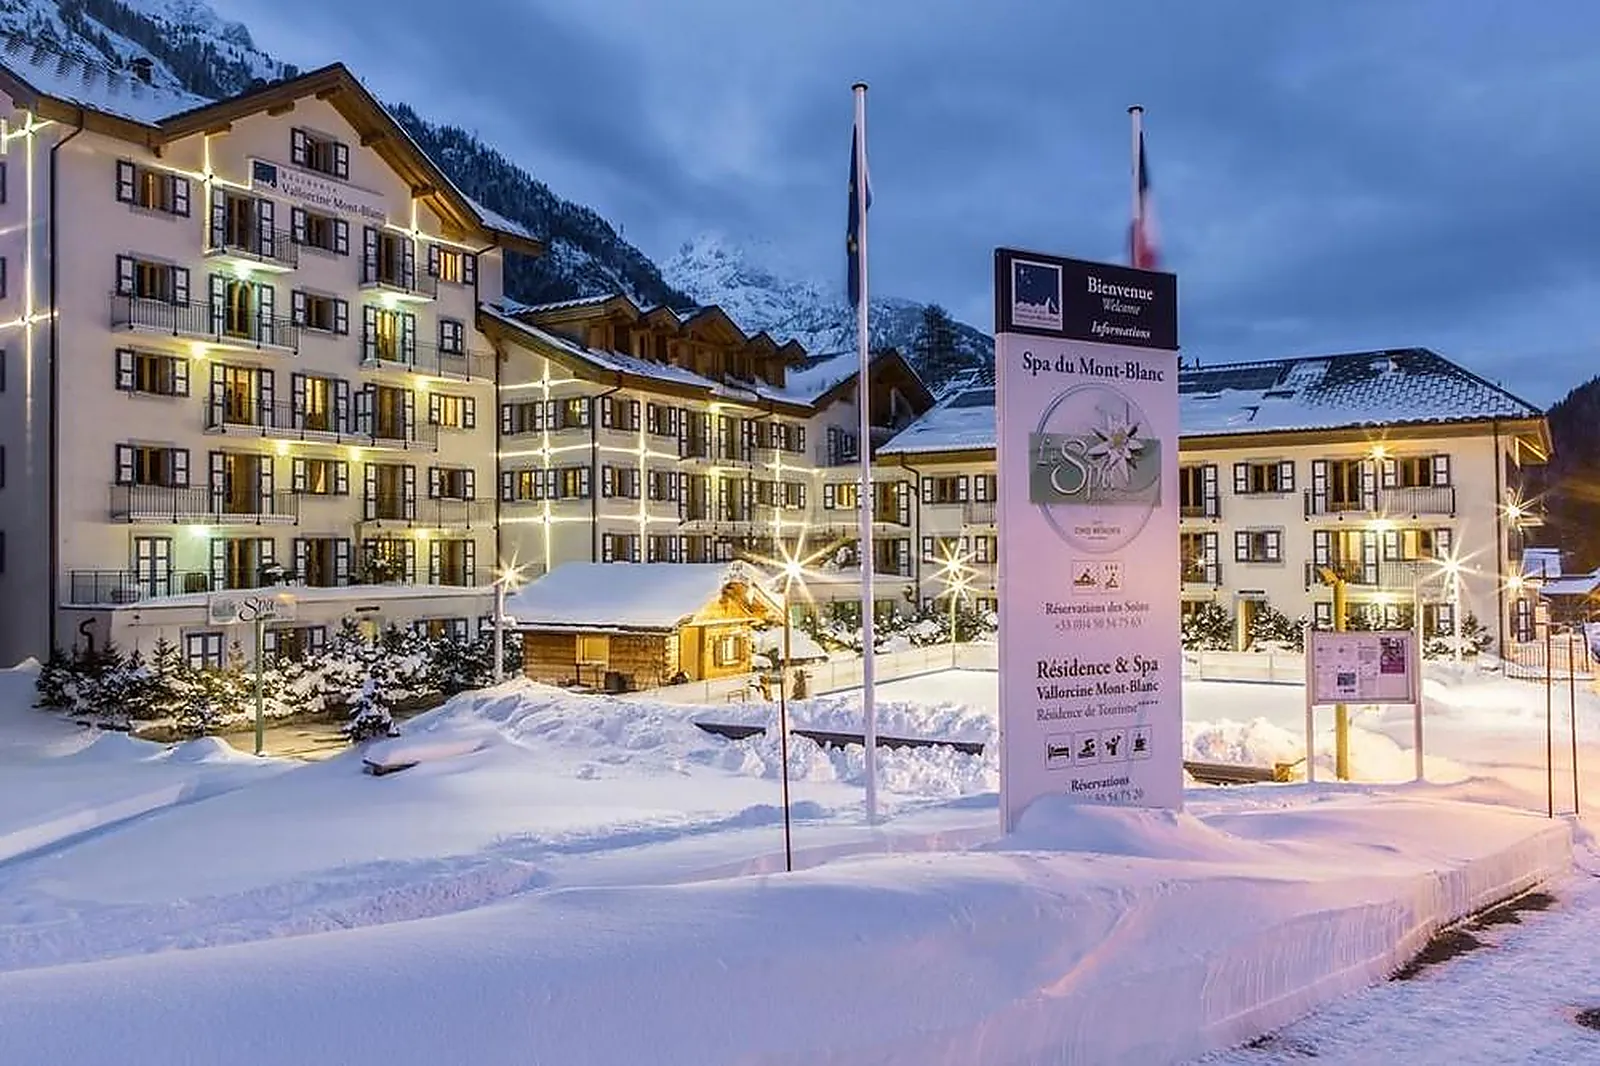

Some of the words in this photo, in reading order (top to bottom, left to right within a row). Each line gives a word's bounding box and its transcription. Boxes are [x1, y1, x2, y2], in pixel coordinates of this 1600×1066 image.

[1087, 276, 1154, 301] Bienvenue
[1102, 297, 1142, 316] Welcome
[1091, 320, 1151, 340] Informations
[1022, 351, 1051, 376] Spa
[1055, 355, 1075, 374] du
[1079, 357, 1165, 382] Mont-Blanc
[1050, 438, 1115, 499] Spa
[1045, 602, 1105, 615] Réservations
[1036, 658, 1110, 680] Résidence
[1115, 656, 1128, 674] &
[1133, 655, 1159, 677] Spa
[1036, 683, 1093, 700] Vallorcine
[1095, 679, 1159, 698] Mont-Blanc
[1036, 706, 1082, 721] Résidence
[1084, 704, 1096, 717] de
[1071, 776, 1129, 792] Réservations
